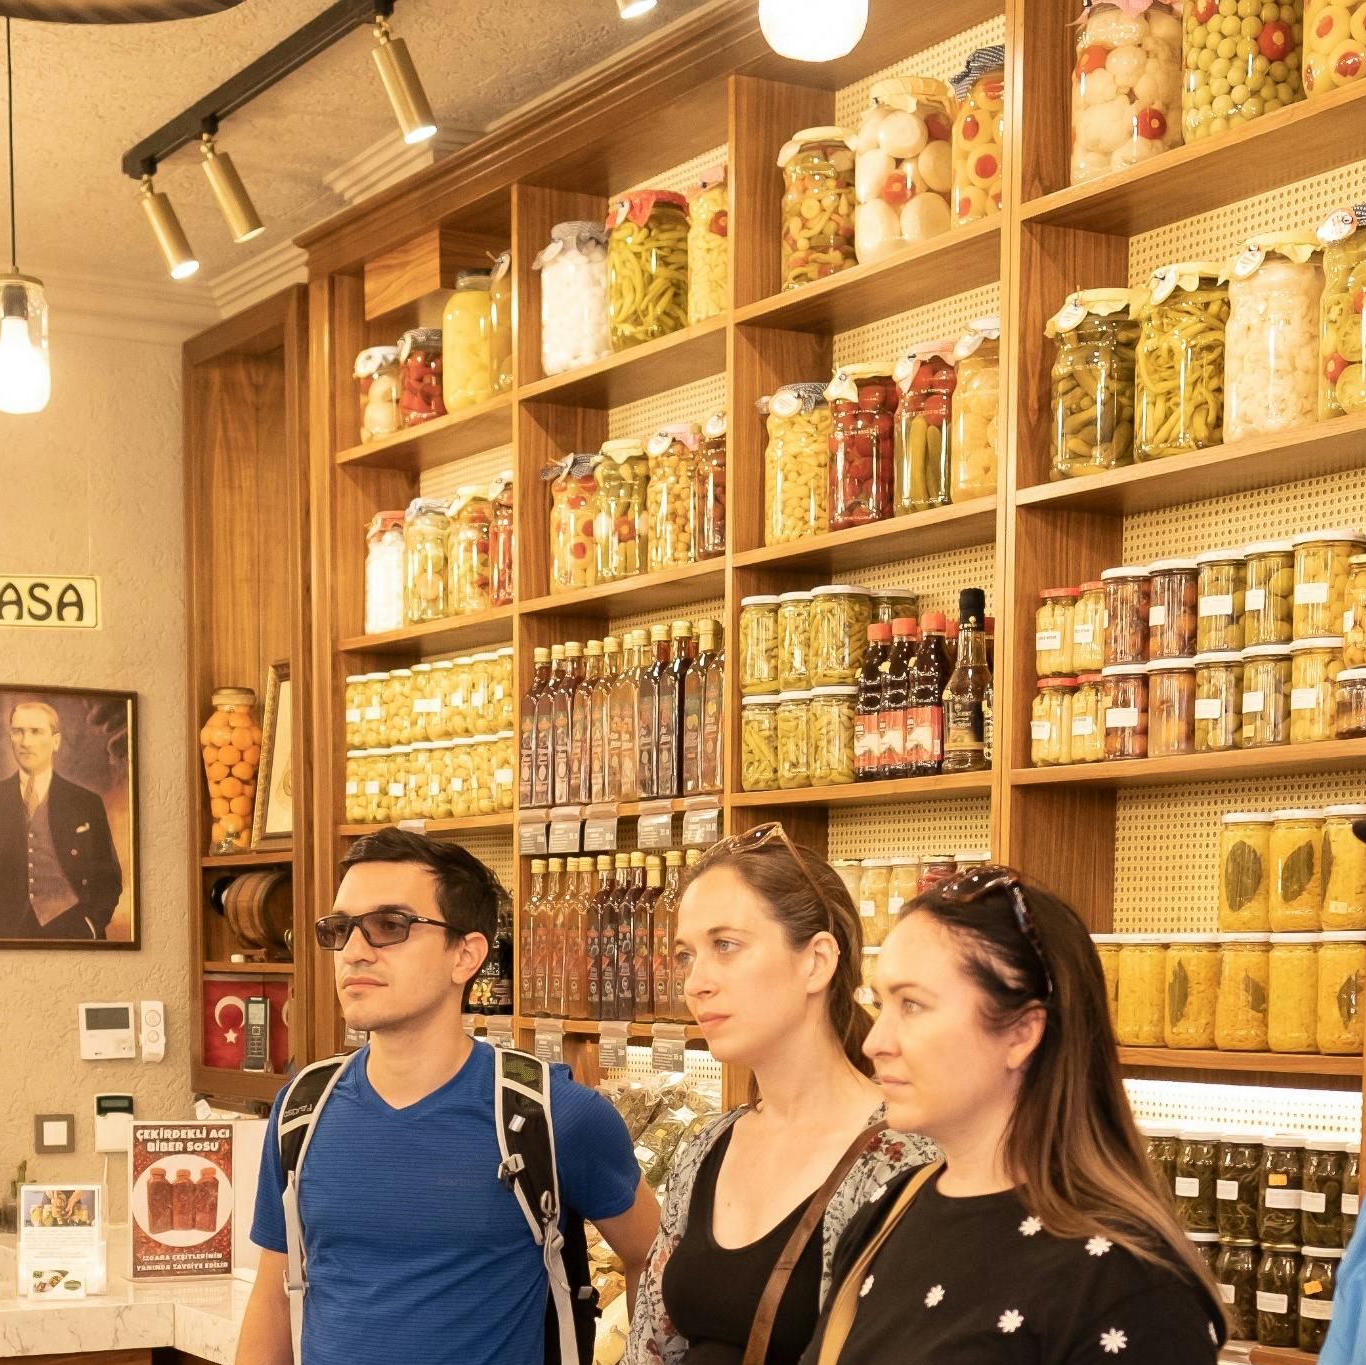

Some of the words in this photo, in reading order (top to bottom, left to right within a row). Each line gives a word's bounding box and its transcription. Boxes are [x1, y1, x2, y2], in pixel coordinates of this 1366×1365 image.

[136, 1126, 207, 1143] ÇEKİRDEKLİ
[209, 1128, 230, 1139] ACI
[147, 1140, 184, 1153] BİBER
[187, 1141, 220, 1152] SOSU
